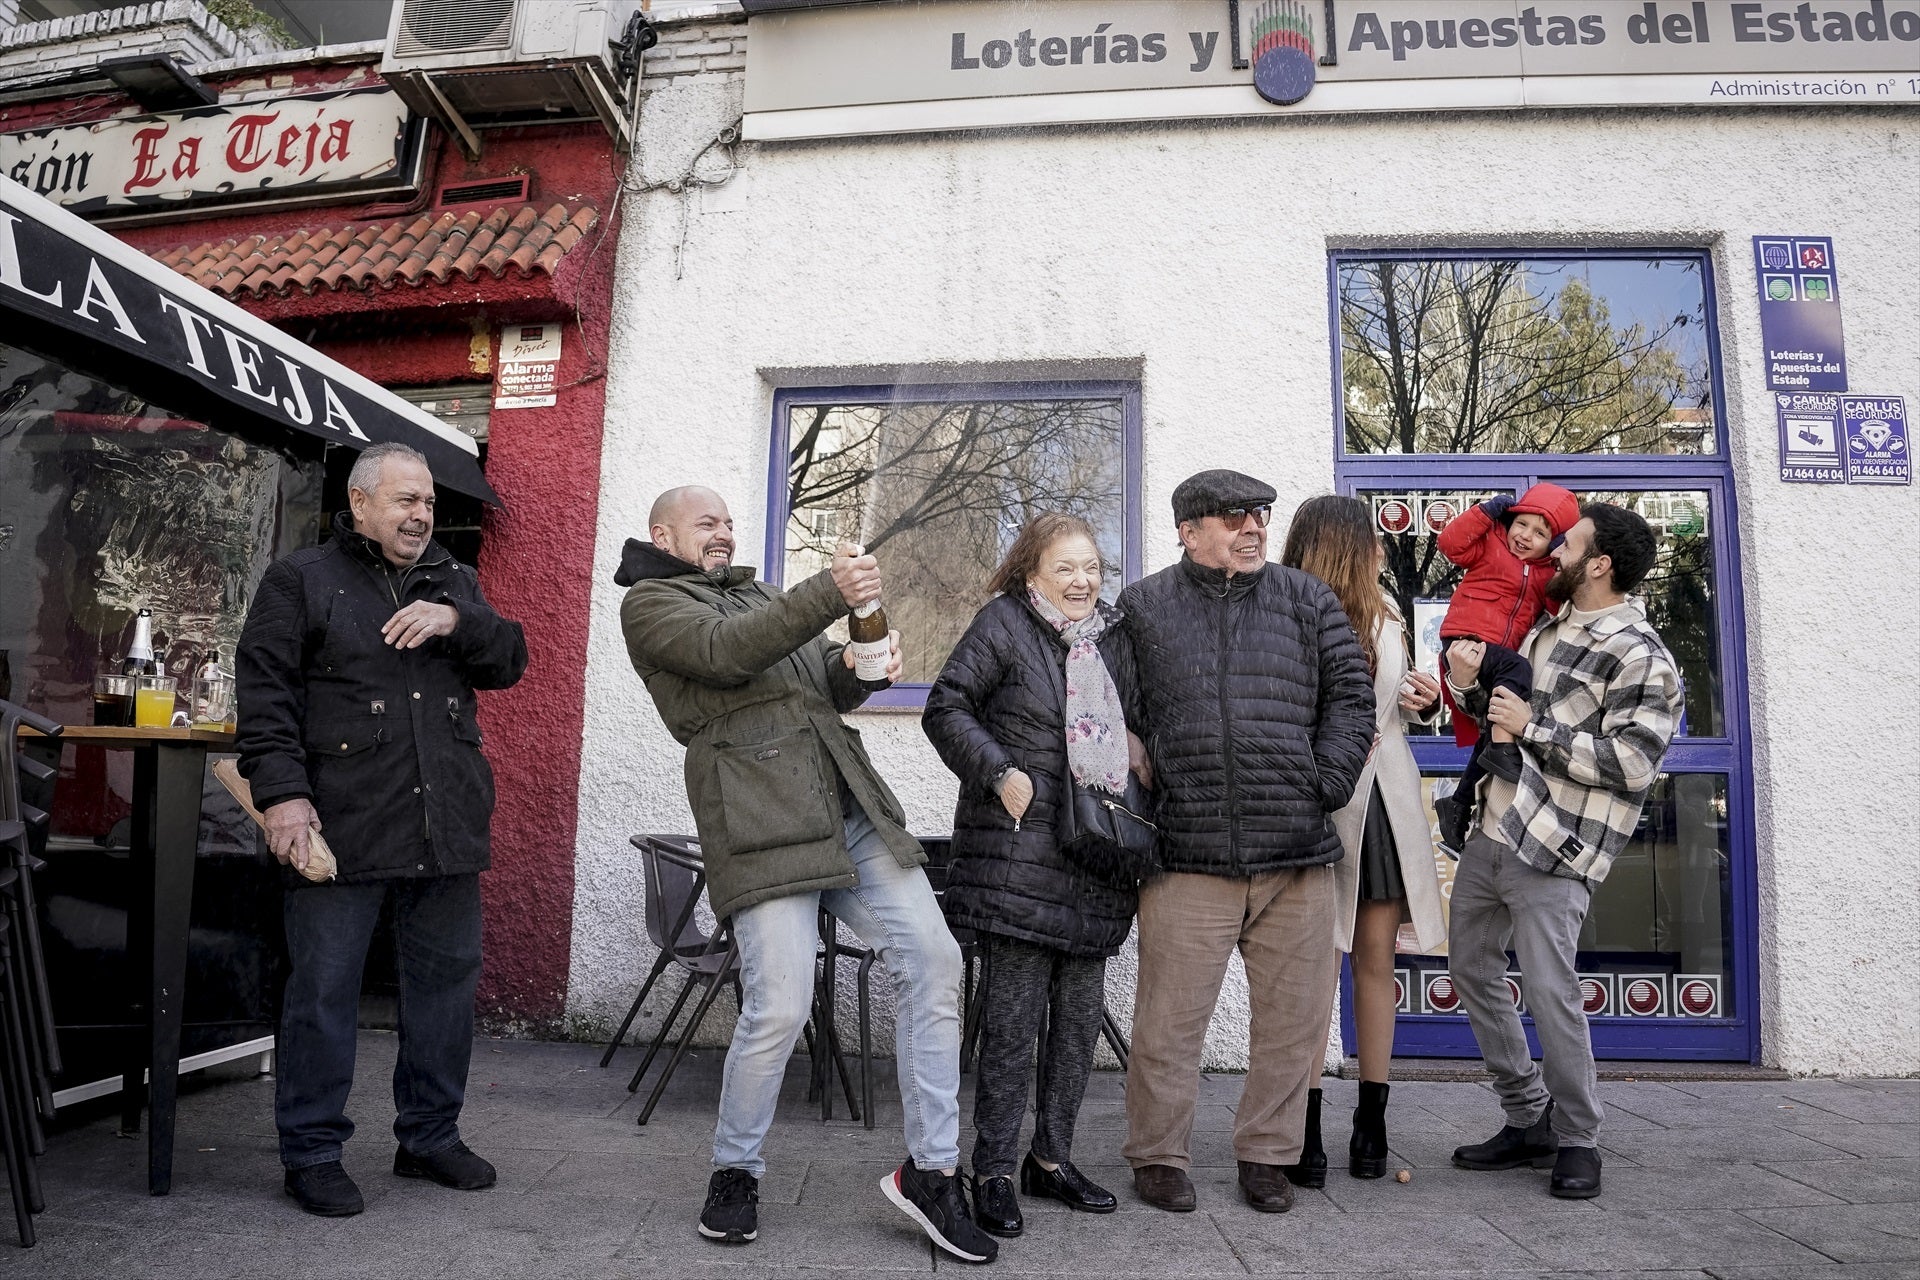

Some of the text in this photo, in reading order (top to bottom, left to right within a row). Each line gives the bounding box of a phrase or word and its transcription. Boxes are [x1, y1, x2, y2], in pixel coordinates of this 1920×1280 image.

[950, 0, 1920, 72] Loterías y Apuestas del Estado
[1710, 79, 1867, 96] Administración
[124, 123, 203, 195] La
[226, 109, 354, 176] Teja
[0, 209, 371, 442] LA TEJA
[1770, 350, 1824, 363] Loterías y
[502, 362, 555, 375] Alarma
[1772, 362, 1841, 374] Apuestas del
[501, 373, 555, 385] conectada
[1772, 374, 1810, 385] Estado
[1792, 394, 1837, 405] CARLÚS
[1792, 403, 1838, 411] SEGURIDAD
[1844, 400, 1901, 412] CARLÚS
[1845, 411, 1903, 419] SEGURIDAD
[1782, 468, 1844, 481] 91 464 64 04
[1850, 465, 1908, 476] 91 464 64 04
